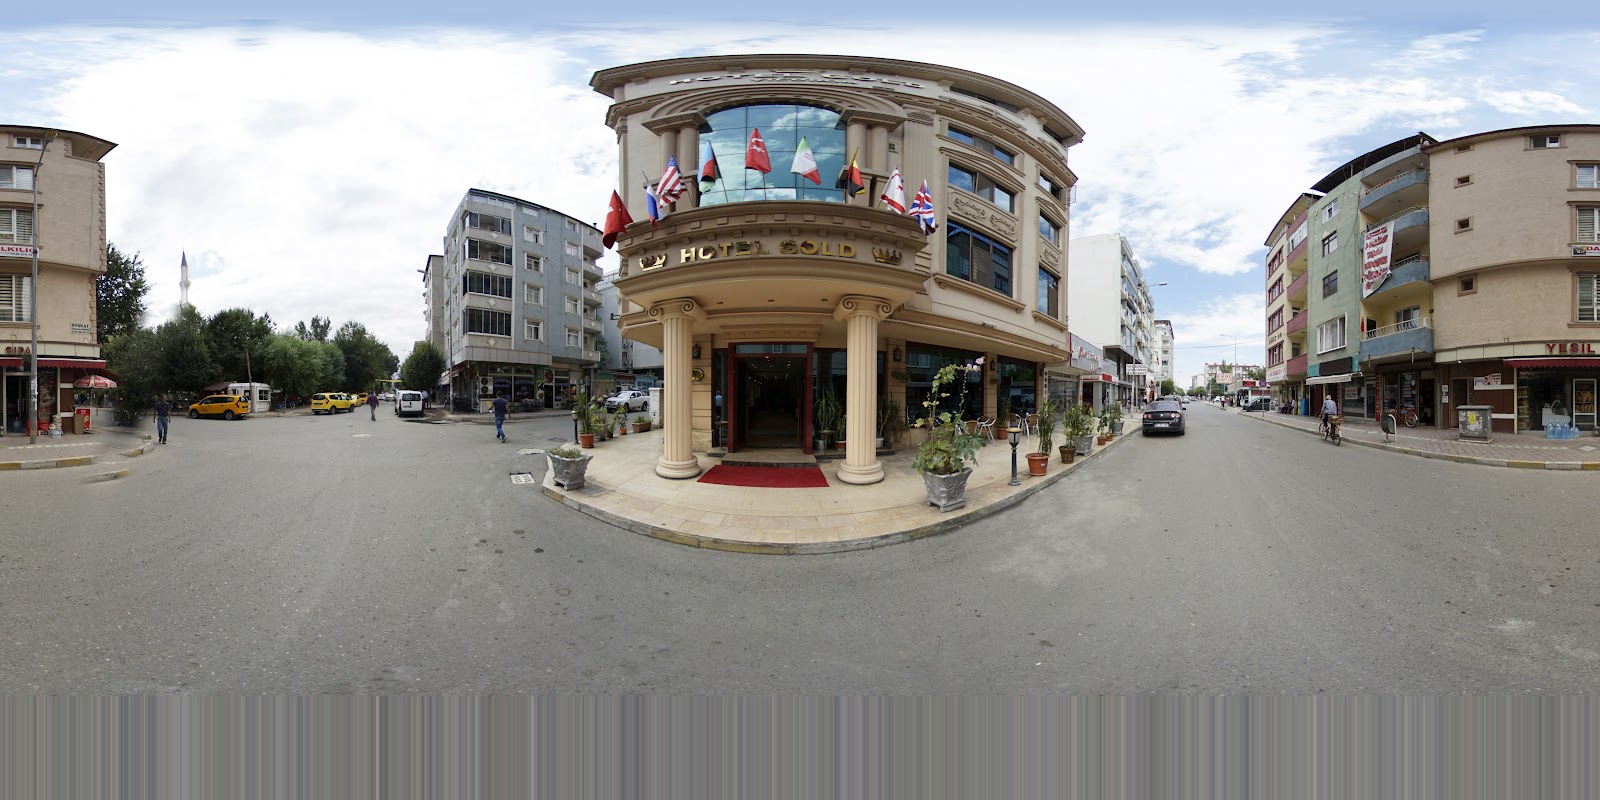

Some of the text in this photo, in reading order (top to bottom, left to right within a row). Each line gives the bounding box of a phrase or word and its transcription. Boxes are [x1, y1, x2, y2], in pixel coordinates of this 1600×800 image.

[821, 73, 925, 88] GOLD
[680, 240, 857, 264] HOTEL GOLD
